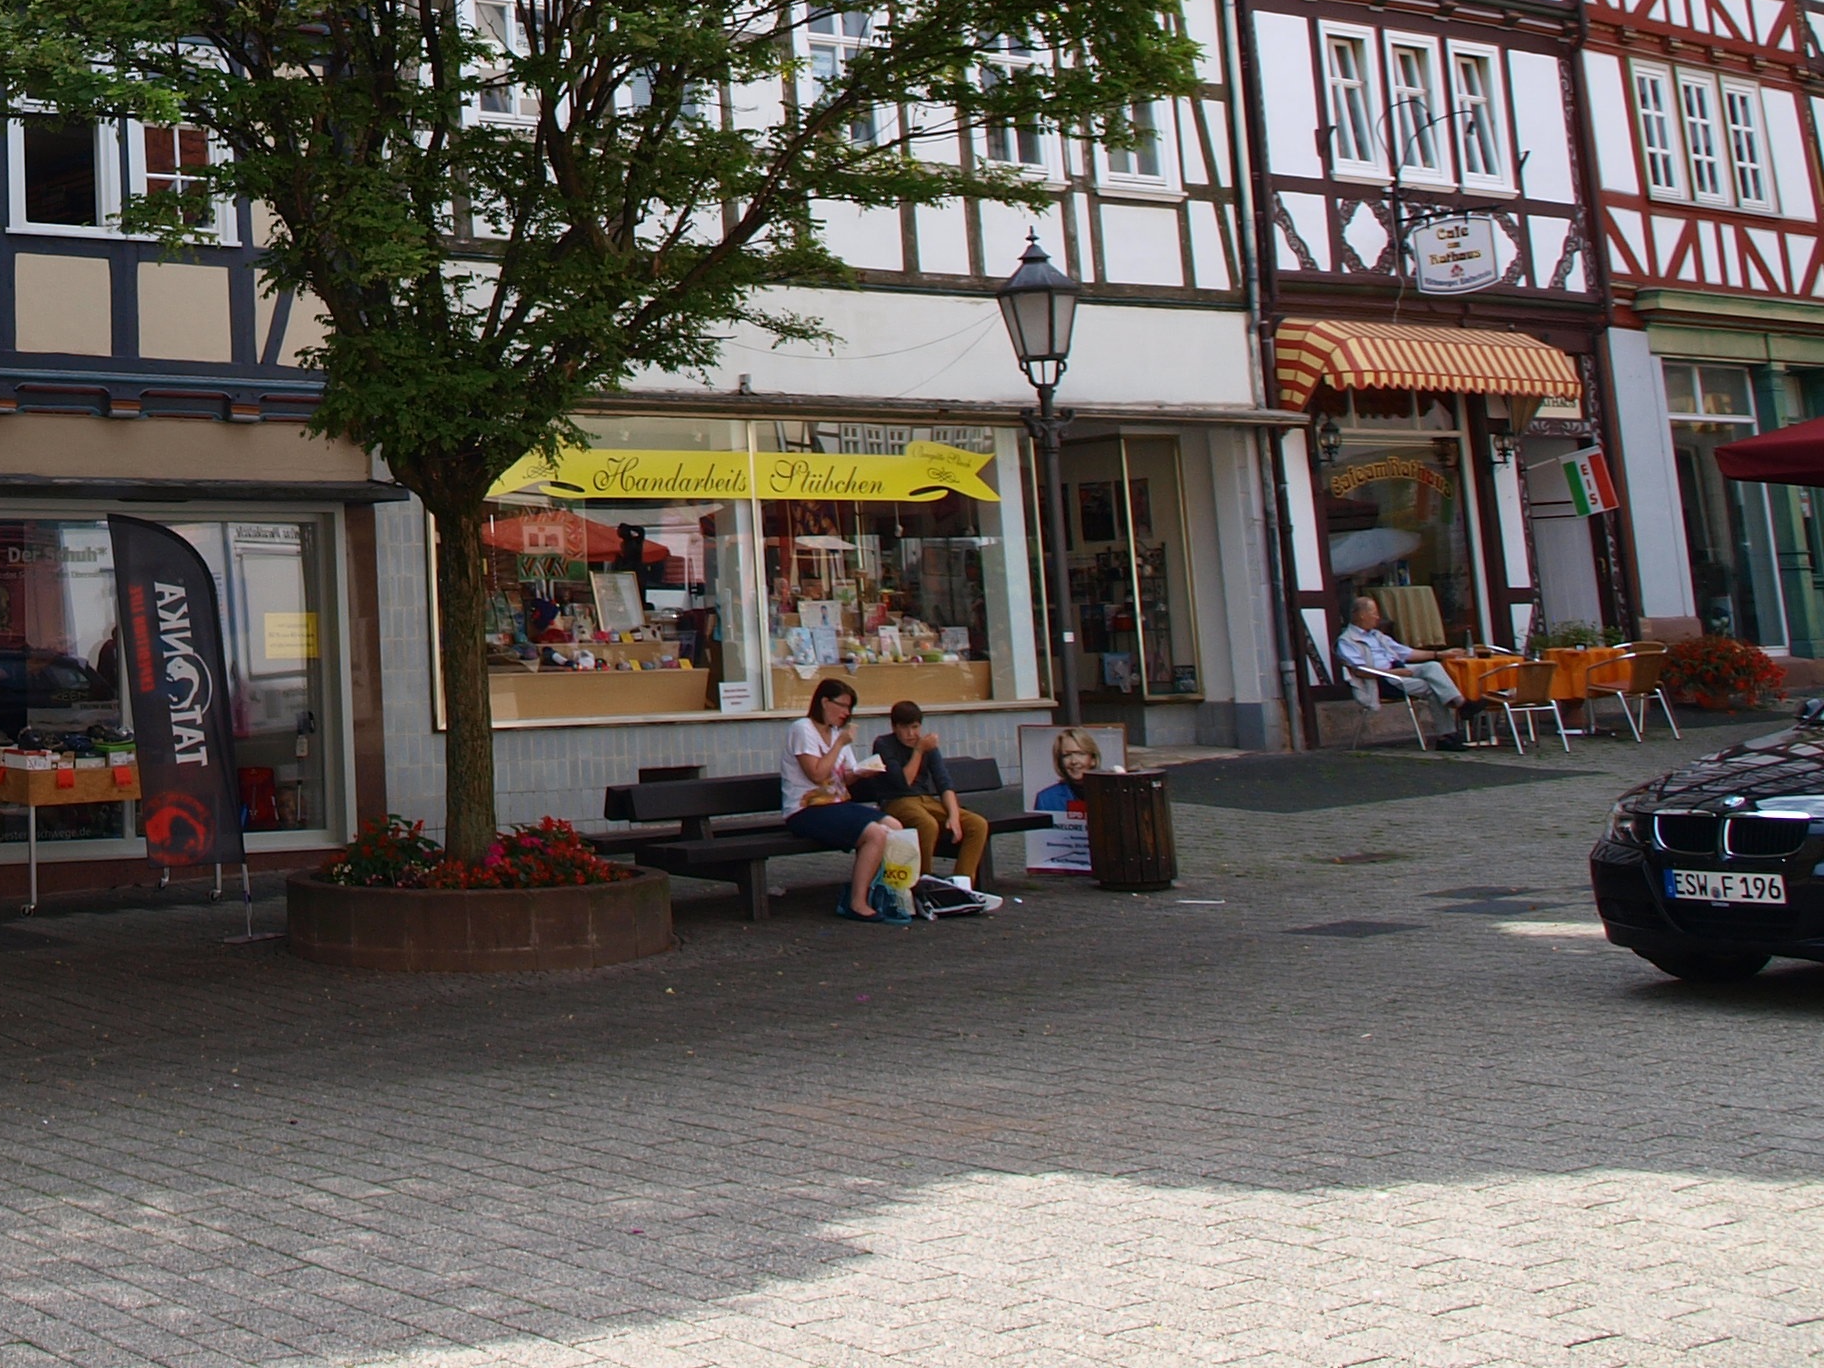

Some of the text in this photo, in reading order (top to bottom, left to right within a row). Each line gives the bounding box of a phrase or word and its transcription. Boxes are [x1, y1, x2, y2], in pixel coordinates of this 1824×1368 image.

[592, 456, 885, 495] Handarbeits Stübchen
[1579, 463, 1599, 506] EIS
[7, 546, 40, 563] Der
[1674, 873, 1782, 900] ESW F 196
